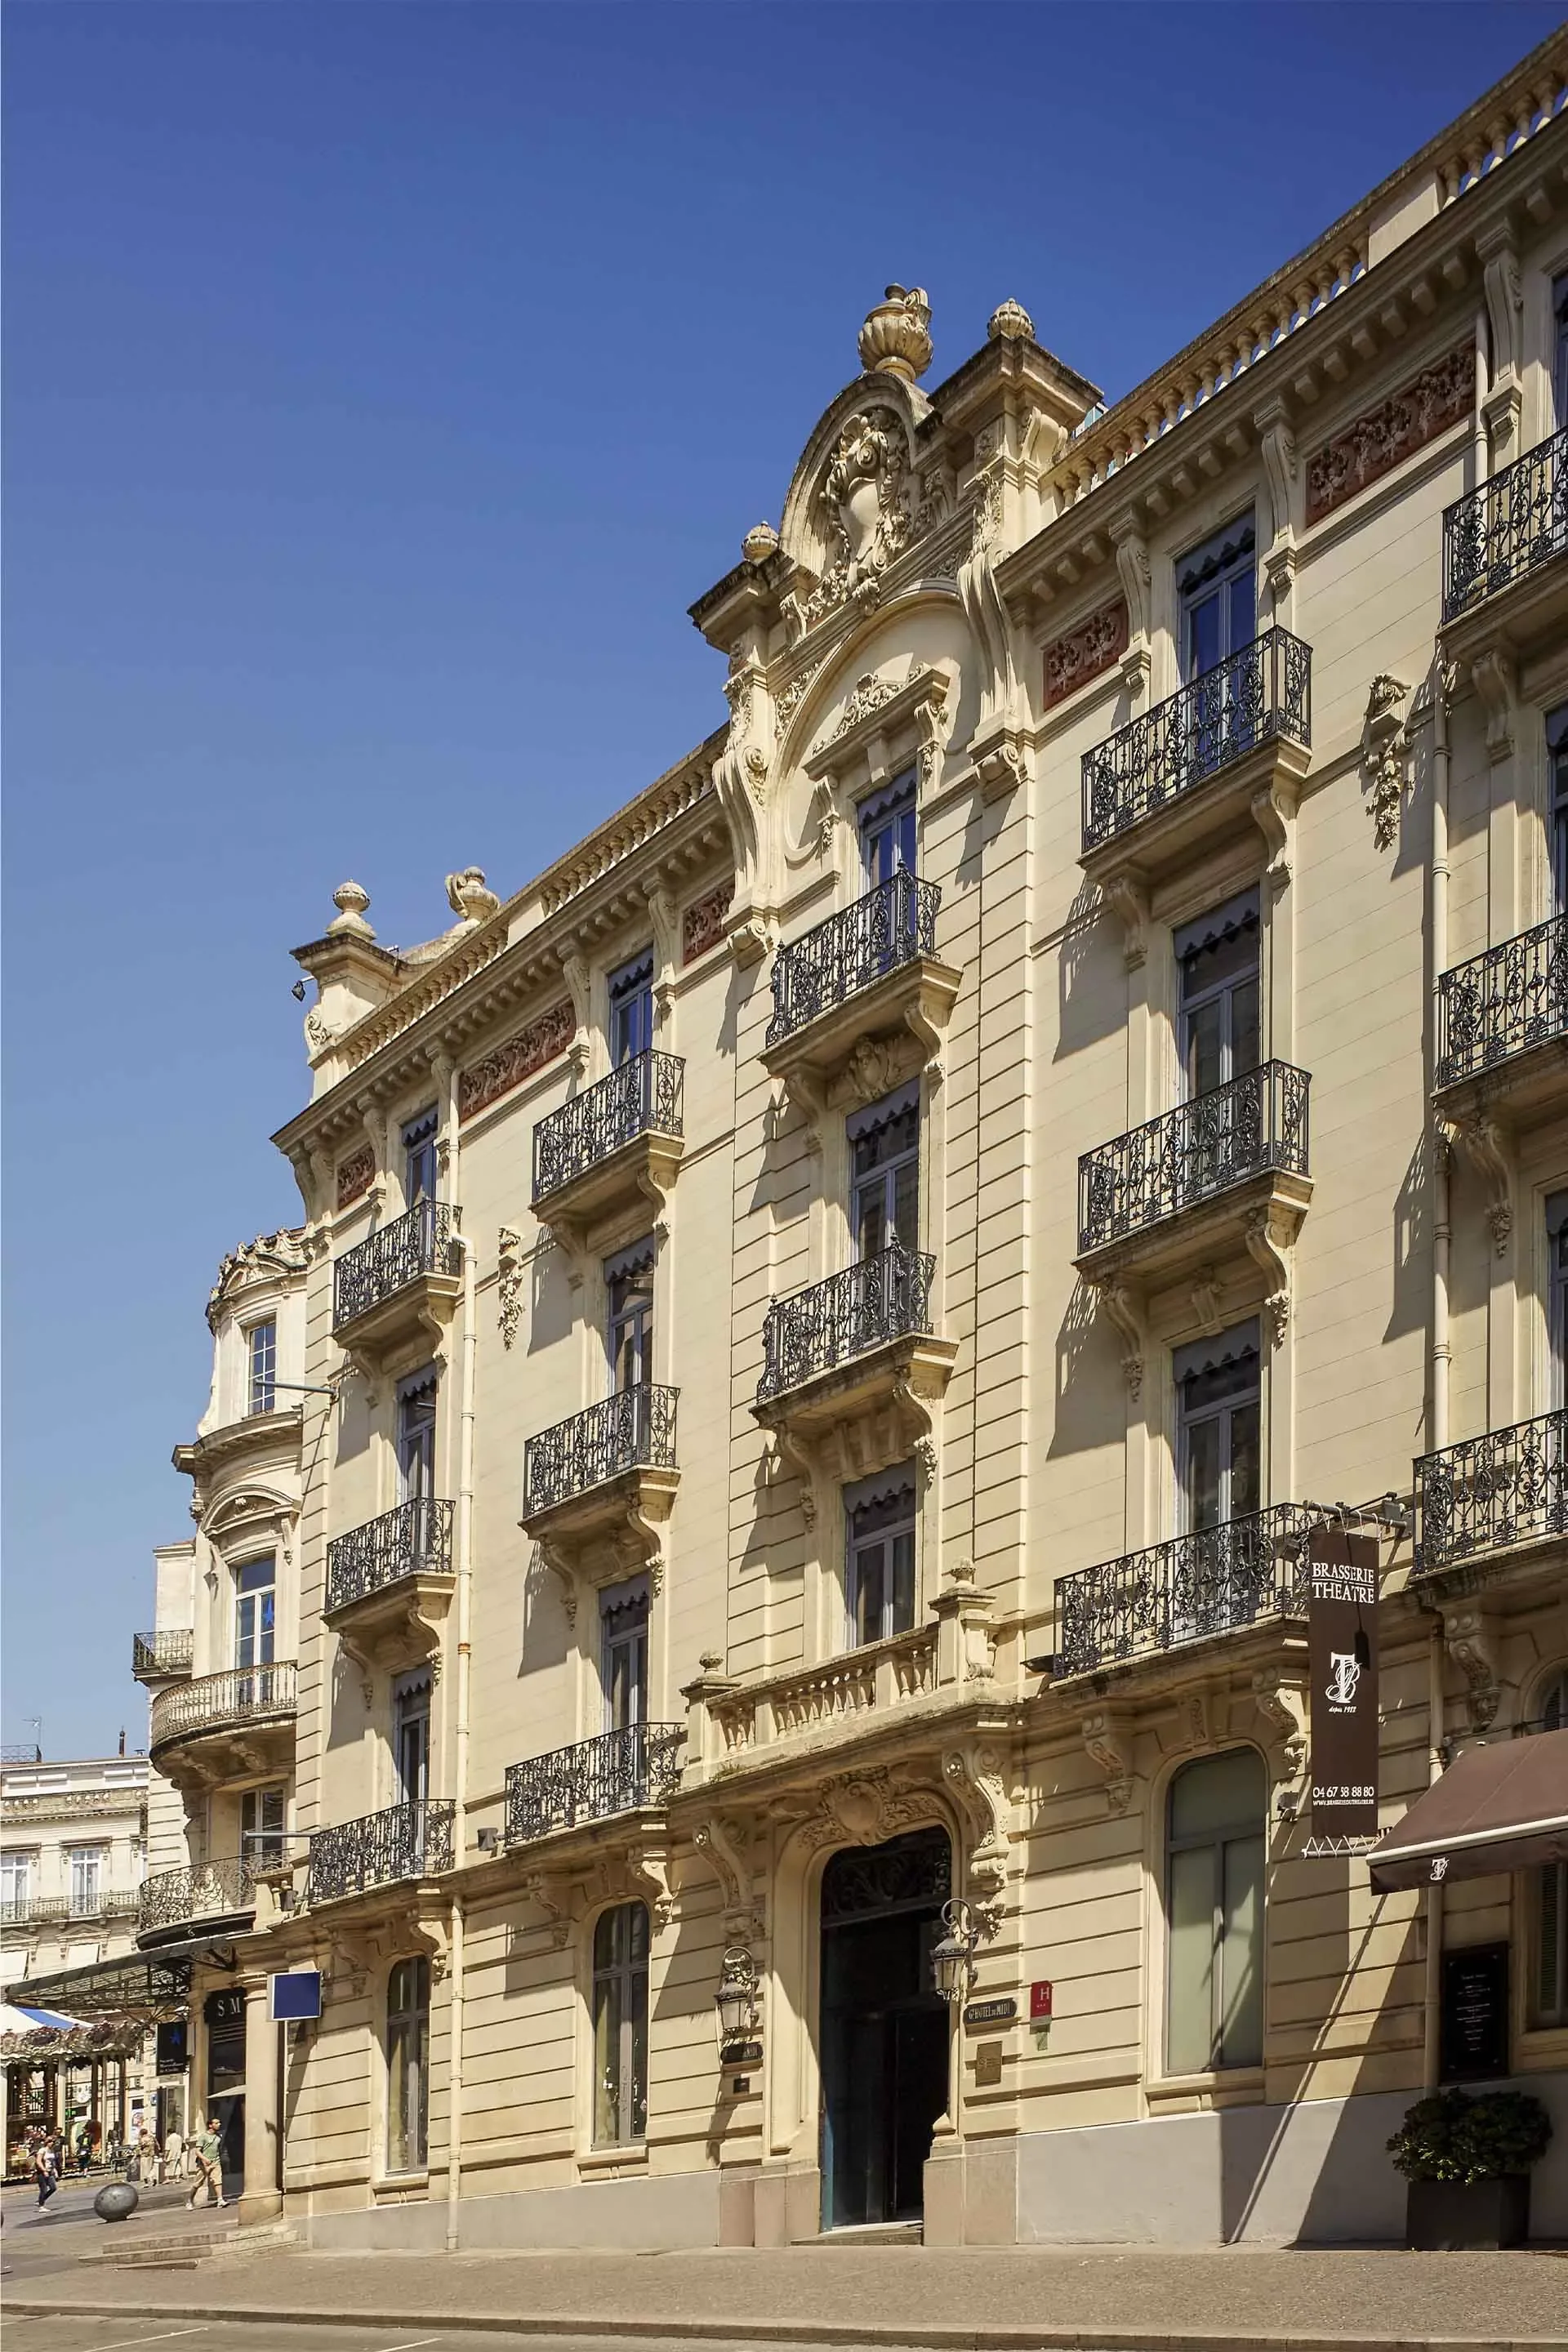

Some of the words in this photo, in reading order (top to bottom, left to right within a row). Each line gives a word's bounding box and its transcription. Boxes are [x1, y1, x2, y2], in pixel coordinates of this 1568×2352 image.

[1312, 1561, 1374, 1584] BRASSERIE
[1312, 1786, 1325, 1797] 04
[1326, 1786, 1339, 1797] 67
[1340, 1786, 1349, 1797] 58
[1351, 1786, 1361, 1797] 88
[1363, 1786, 1374, 1797] 80
[1040, 1987, 1049, 2001] H
